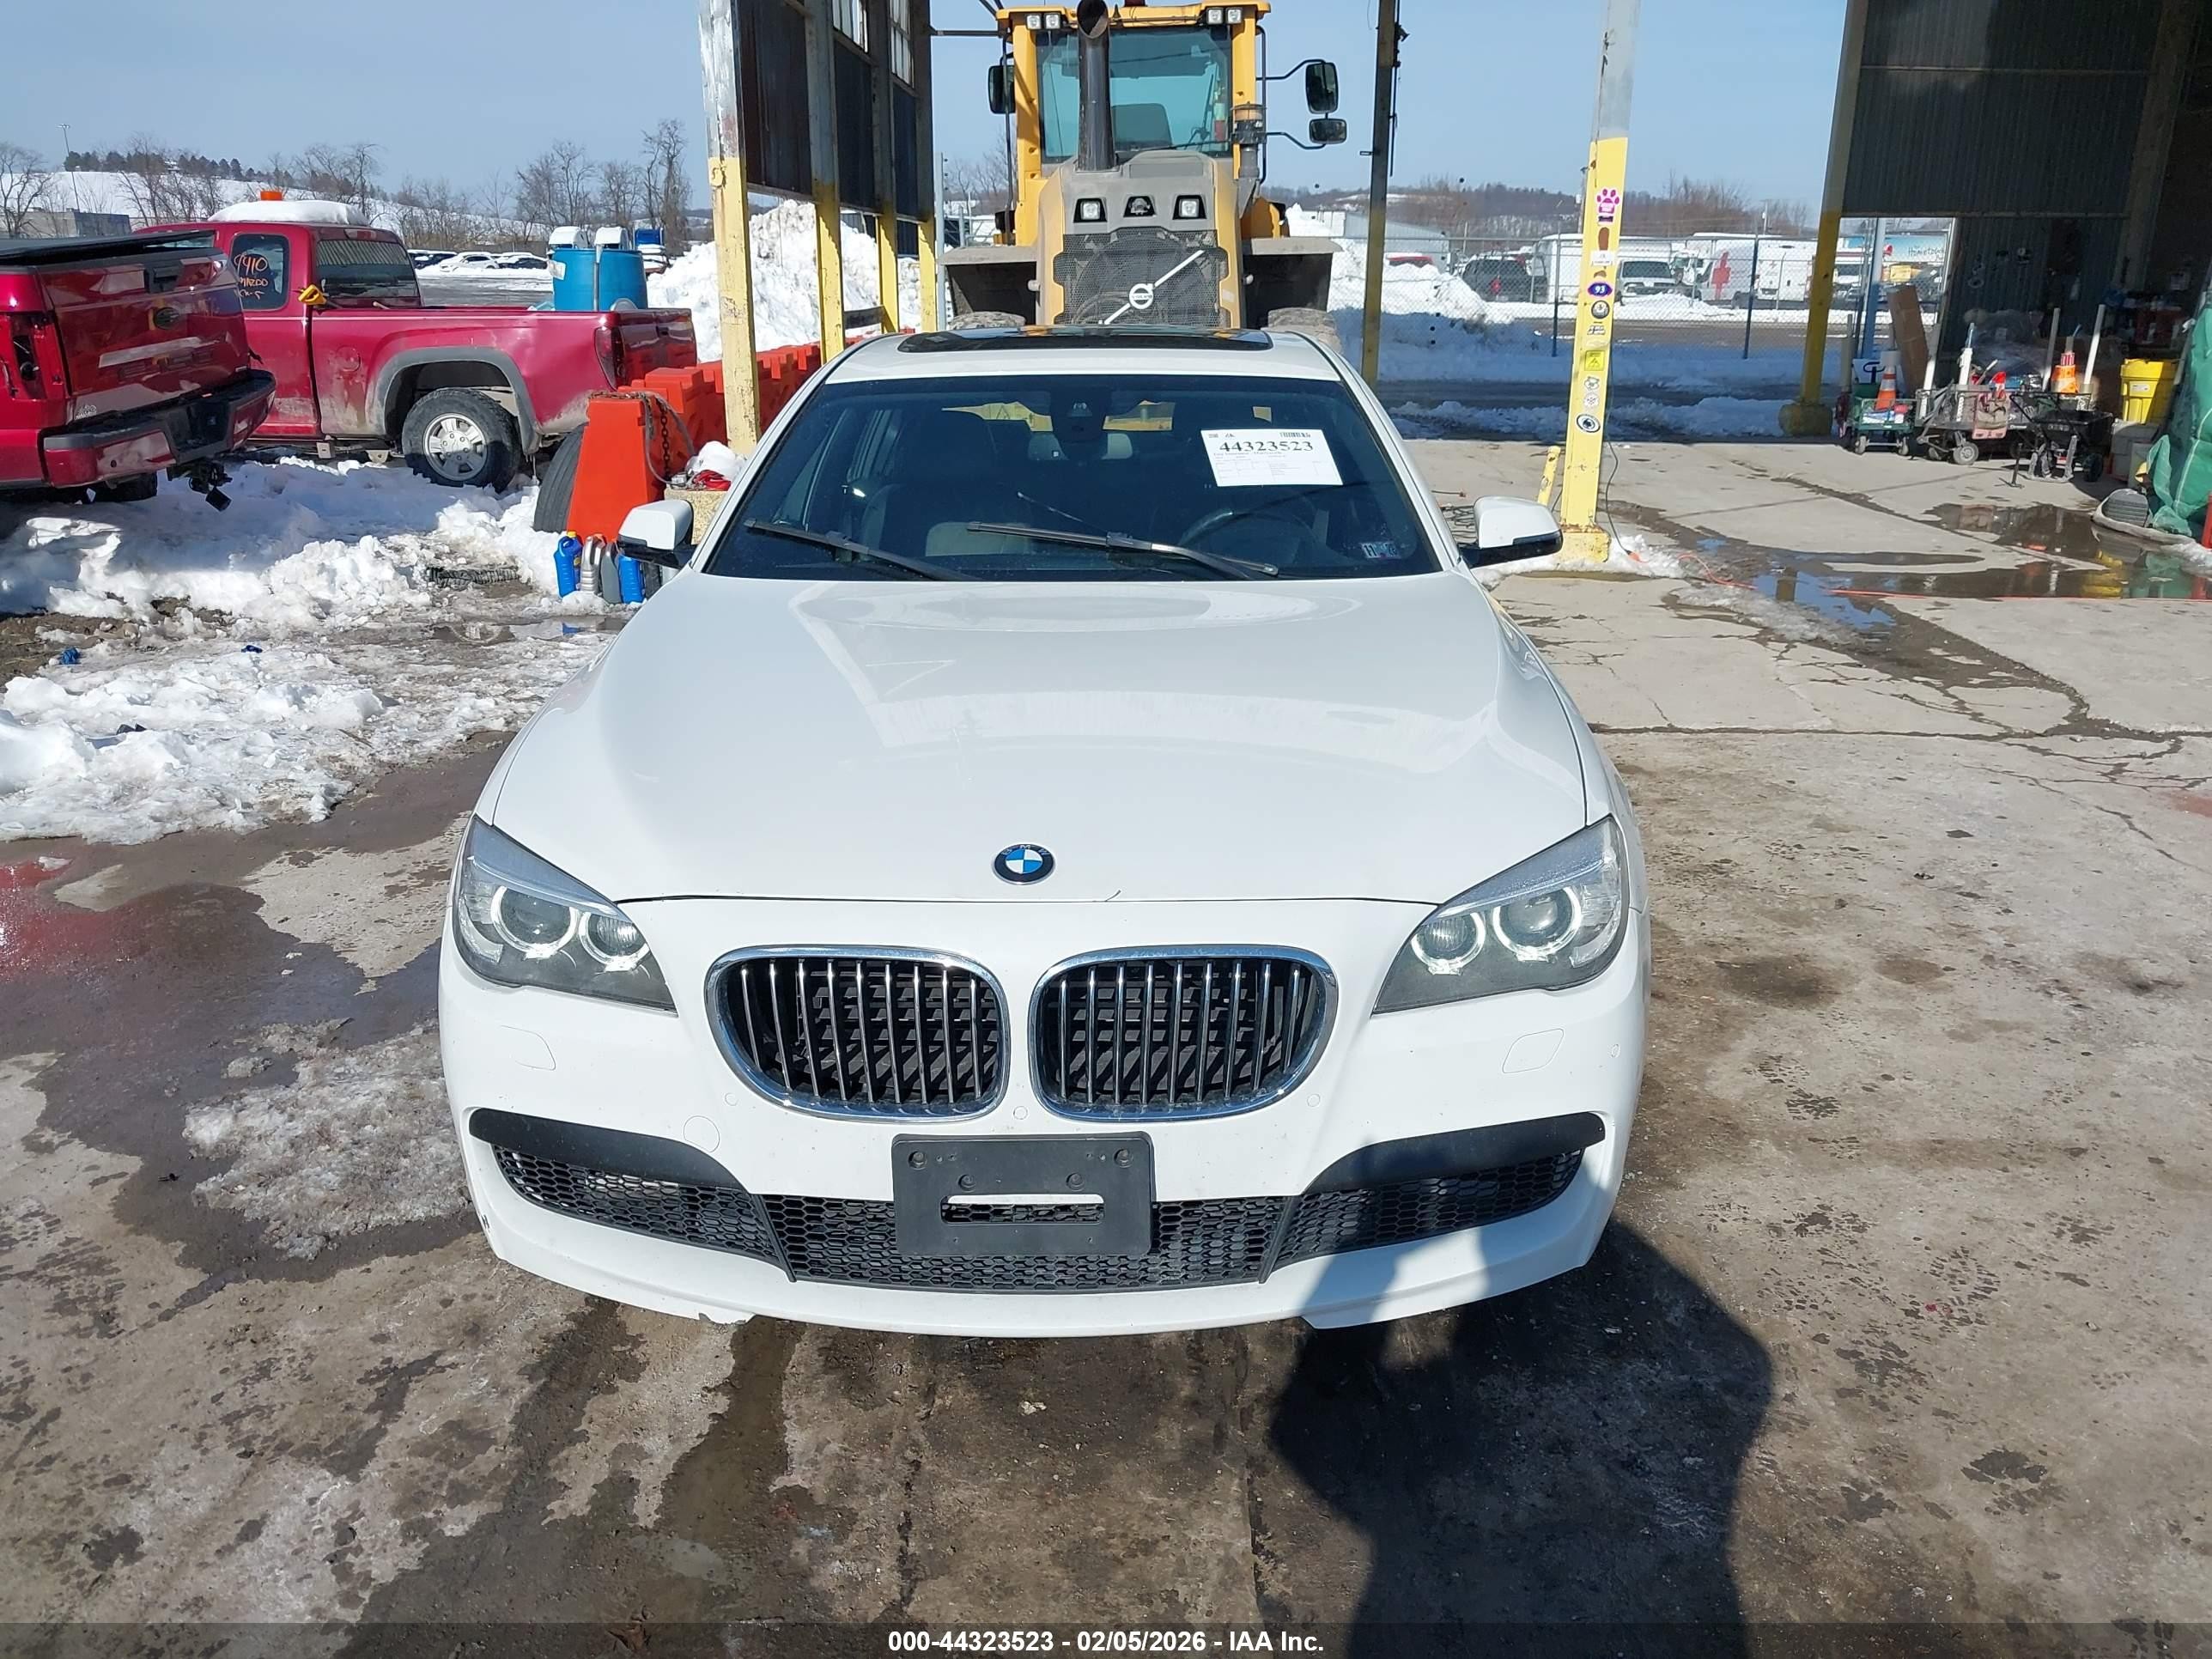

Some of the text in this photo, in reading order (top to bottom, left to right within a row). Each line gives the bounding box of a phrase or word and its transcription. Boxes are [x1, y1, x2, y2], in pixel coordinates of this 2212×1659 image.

[1595, 285, 1607, 295] 93
[1219, 441, 1314, 452] 44323523
[1000, 844, 1051, 856] BMW
